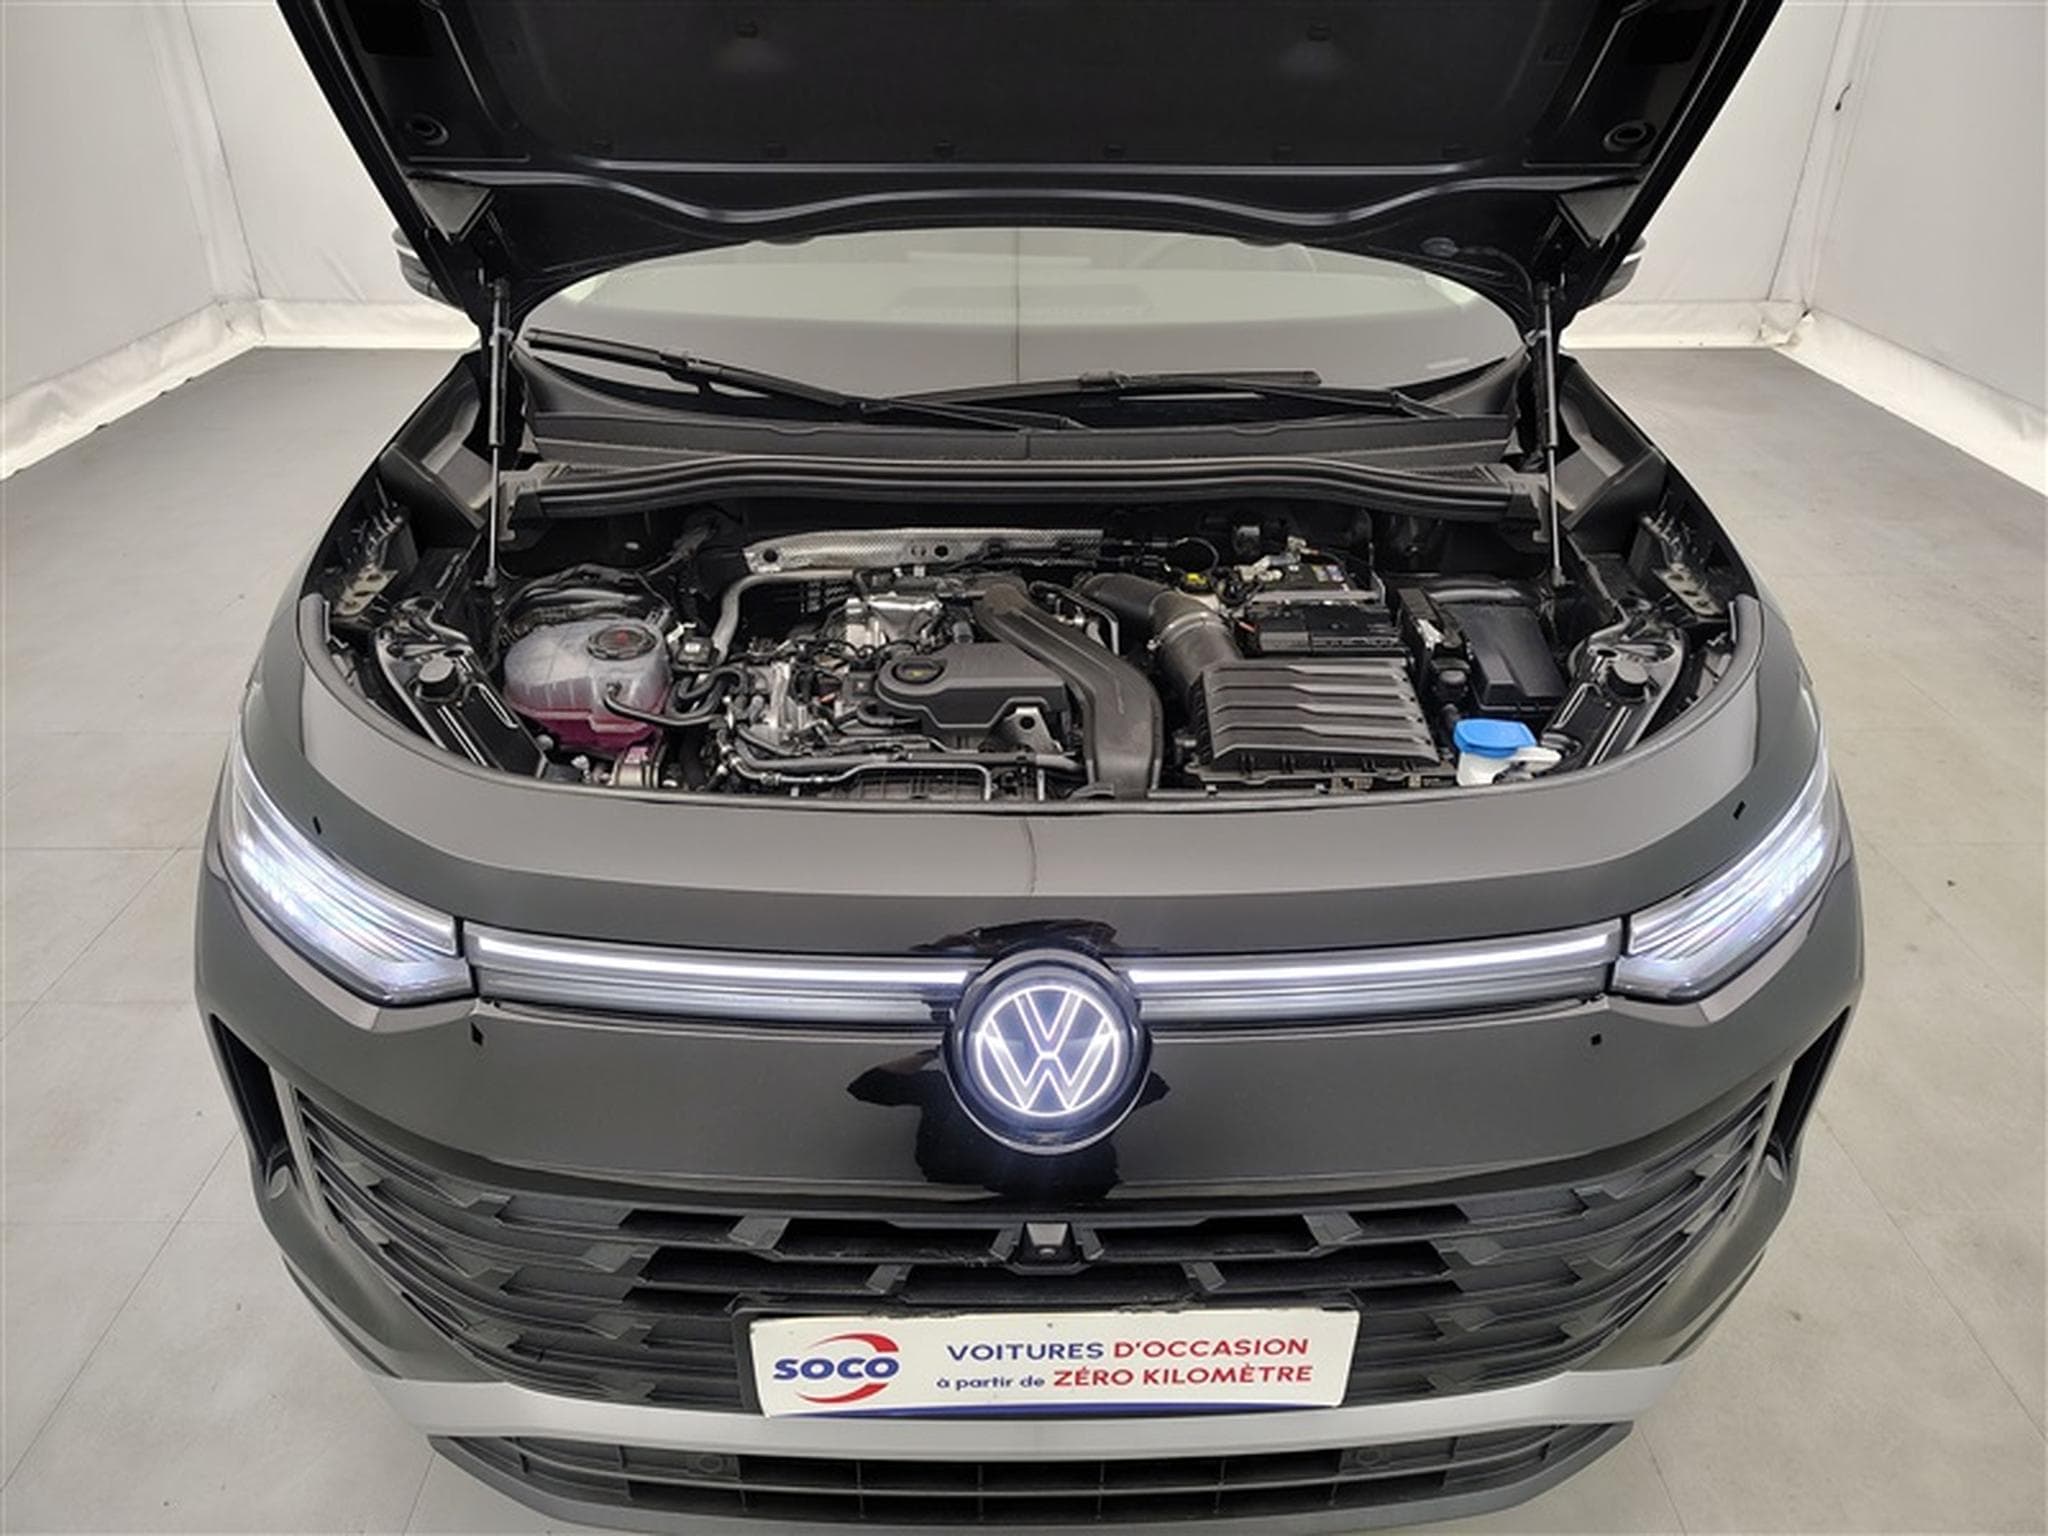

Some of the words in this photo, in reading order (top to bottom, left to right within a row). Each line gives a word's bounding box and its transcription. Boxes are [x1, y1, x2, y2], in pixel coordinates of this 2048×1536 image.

[979, 986, 1118, 1115] VW
[947, 1342, 1104, 1362] VOITURES
[1113, 1338, 1309, 1359] D'OCCASION
[773, 1357, 900, 1381] SOCO
[936, 1376, 950, 1389] à
[955, 1376, 1013, 1391] partir
[1019, 1375, 1045, 1388] de
[1053, 1366, 1134, 1387] ZÉRO
[1143, 1363, 1313, 1385] KILOMÈTRE
